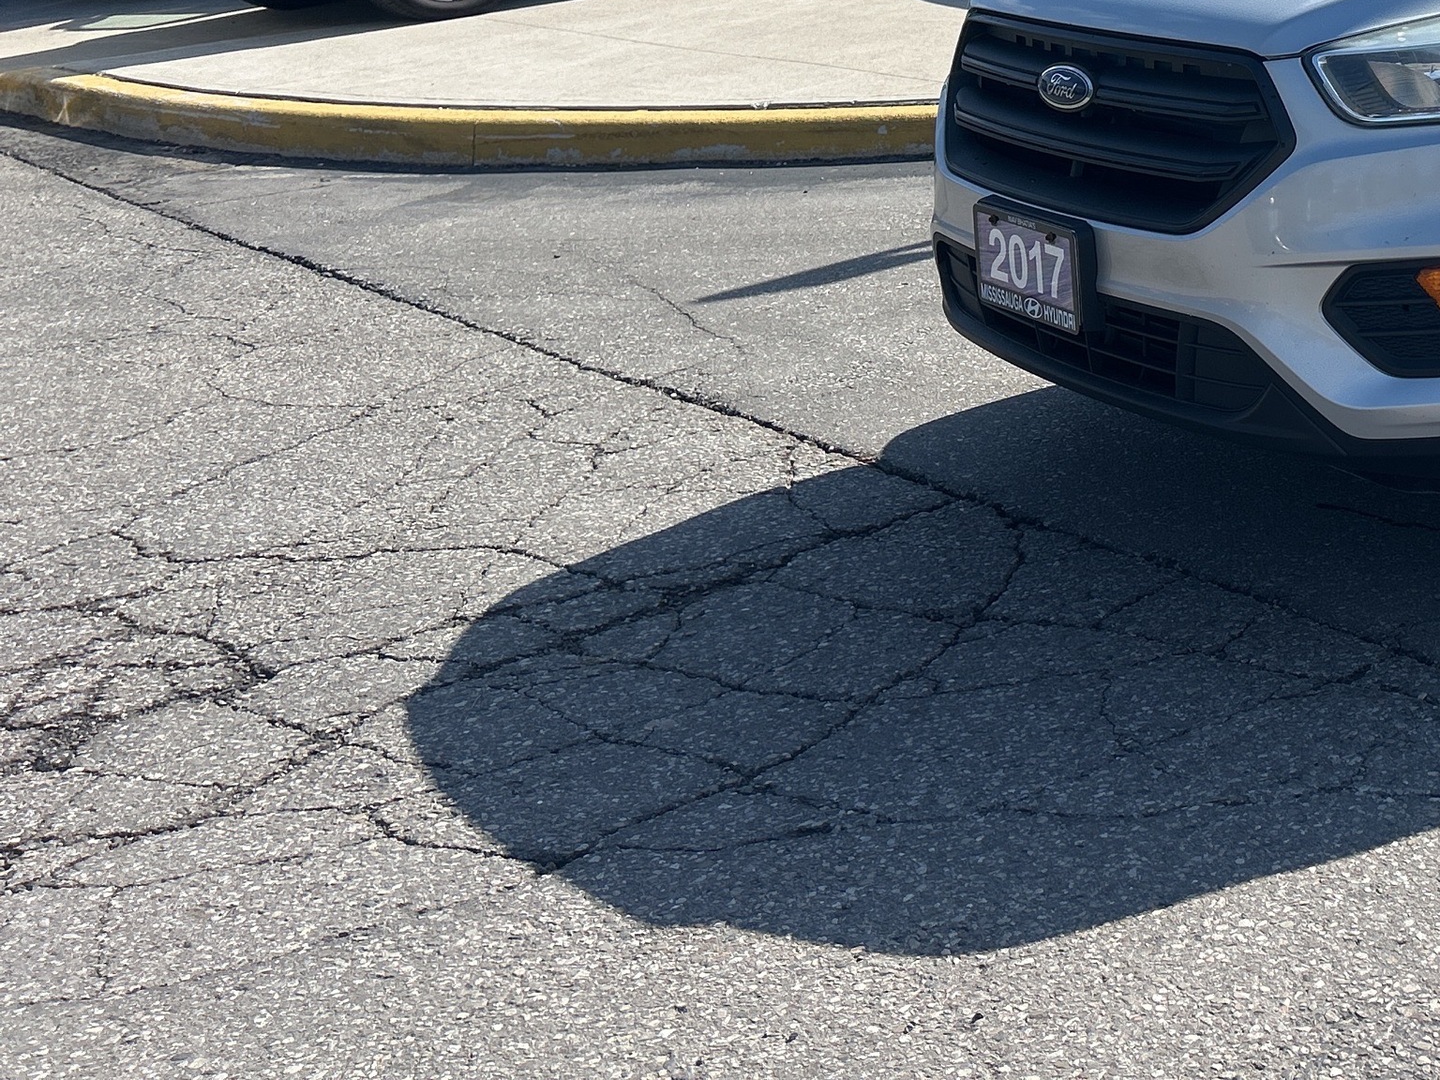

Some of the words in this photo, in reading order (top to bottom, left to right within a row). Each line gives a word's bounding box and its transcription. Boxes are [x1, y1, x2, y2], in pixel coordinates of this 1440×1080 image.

[1046, 72, 1078, 100] Ford
[988, 228, 1065, 299] 2017
[980, 282, 1024, 313] MISSISSAUGA
[1043, 304, 1077, 331] HYUNDAI
